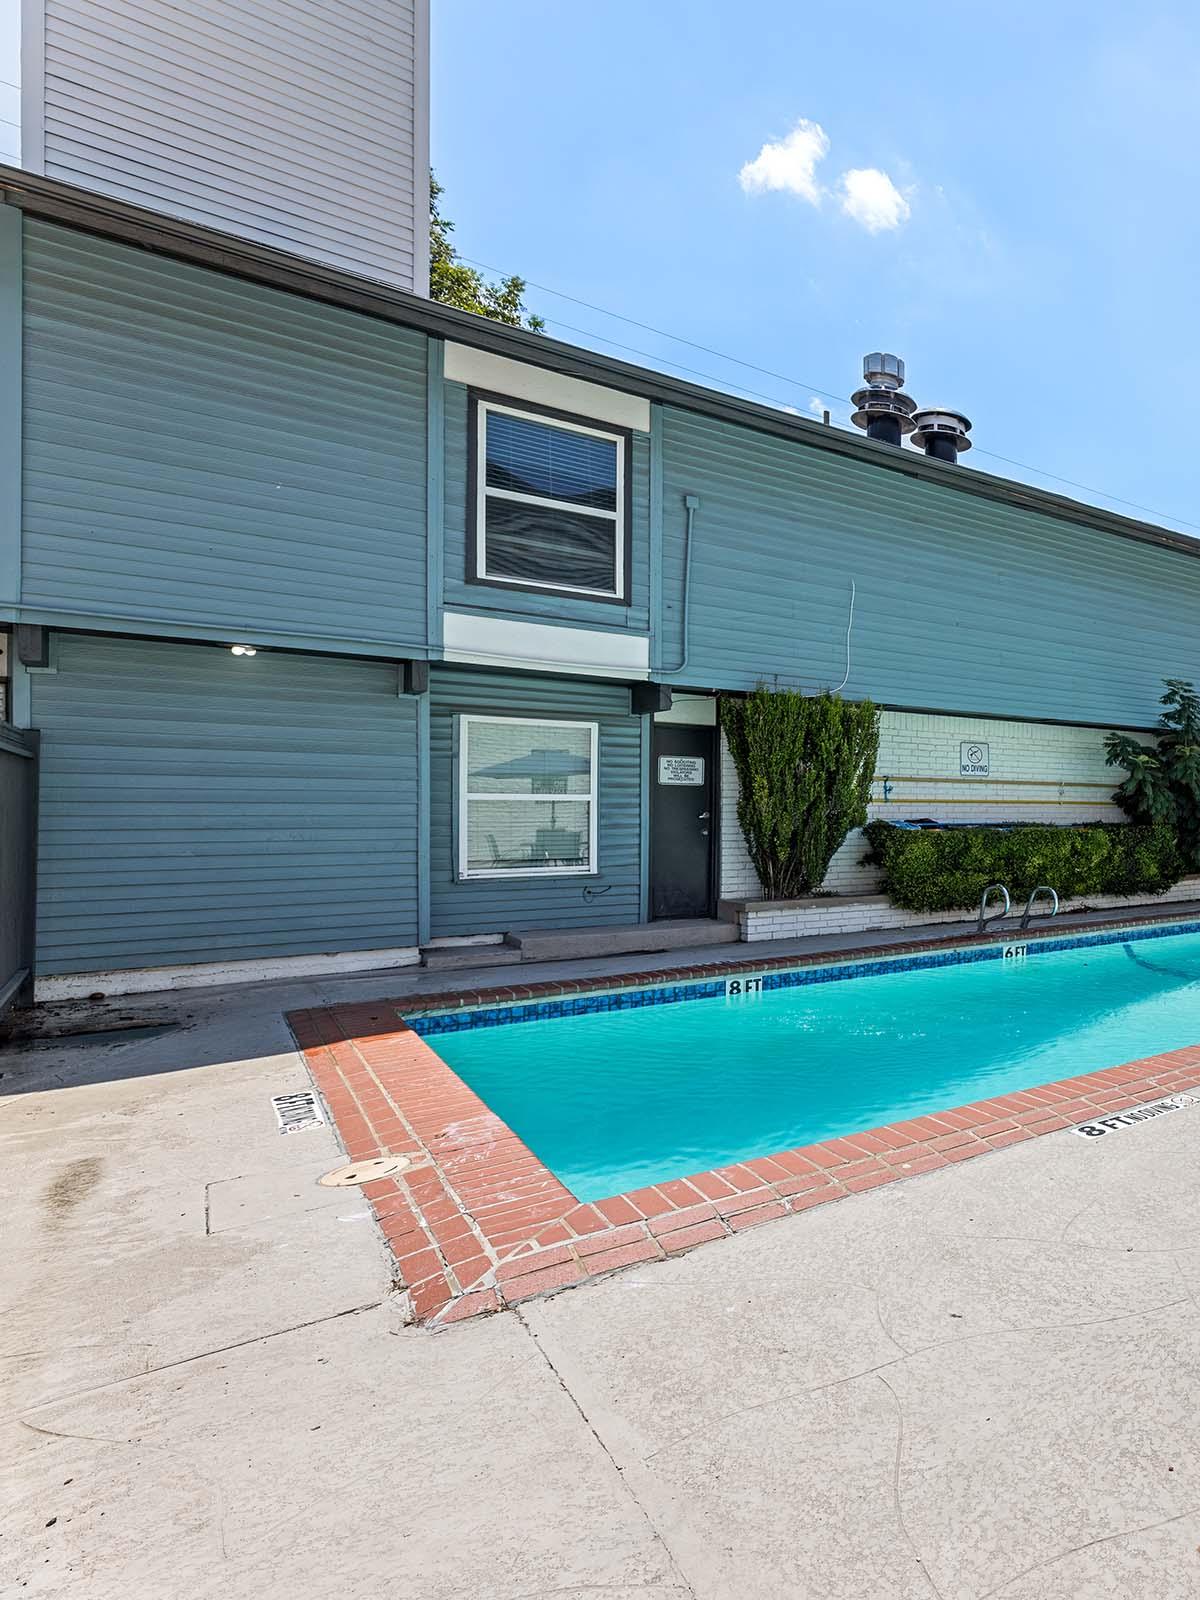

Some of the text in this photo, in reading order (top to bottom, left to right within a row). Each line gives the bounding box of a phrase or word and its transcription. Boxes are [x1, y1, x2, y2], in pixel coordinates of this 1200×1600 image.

[1005, 945, 1026, 958] 6 FT
[729, 978, 762, 995] 8 FT
[273, 1093, 312, 1101] 8
[1078, 1126, 1106, 1137] 8
